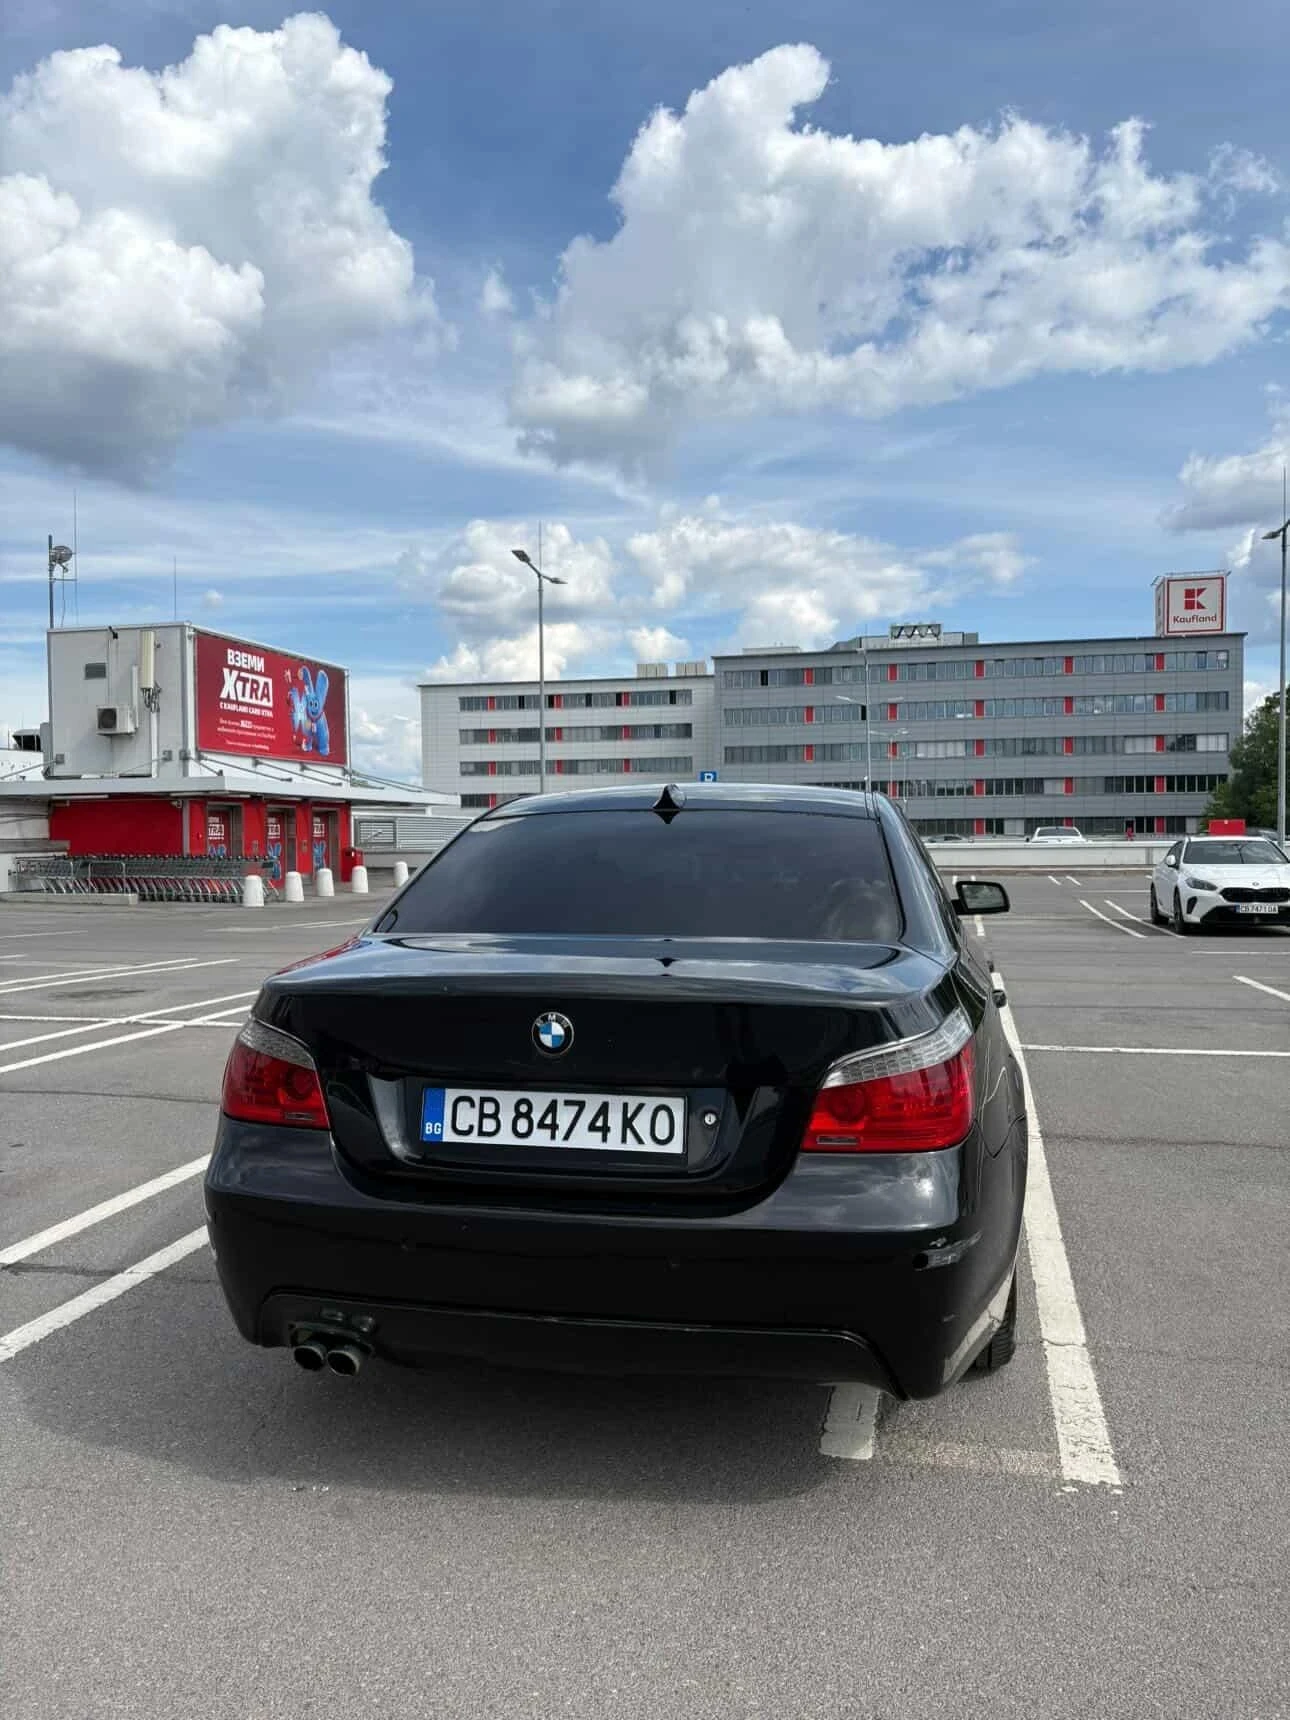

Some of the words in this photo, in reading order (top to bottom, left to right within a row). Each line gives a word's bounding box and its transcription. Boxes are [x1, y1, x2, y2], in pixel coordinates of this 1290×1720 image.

[1173, 613, 1217, 624] Kaufland
[227, 648, 265, 673] ВЗЕМИ
[220, 667, 273, 708] XTRA
[425, 1122, 442, 1135] BG
[450, 1095, 502, 1138] CB
[510, 1097, 612, 1144] 8474
[620, 1101, 676, 1146] KO
